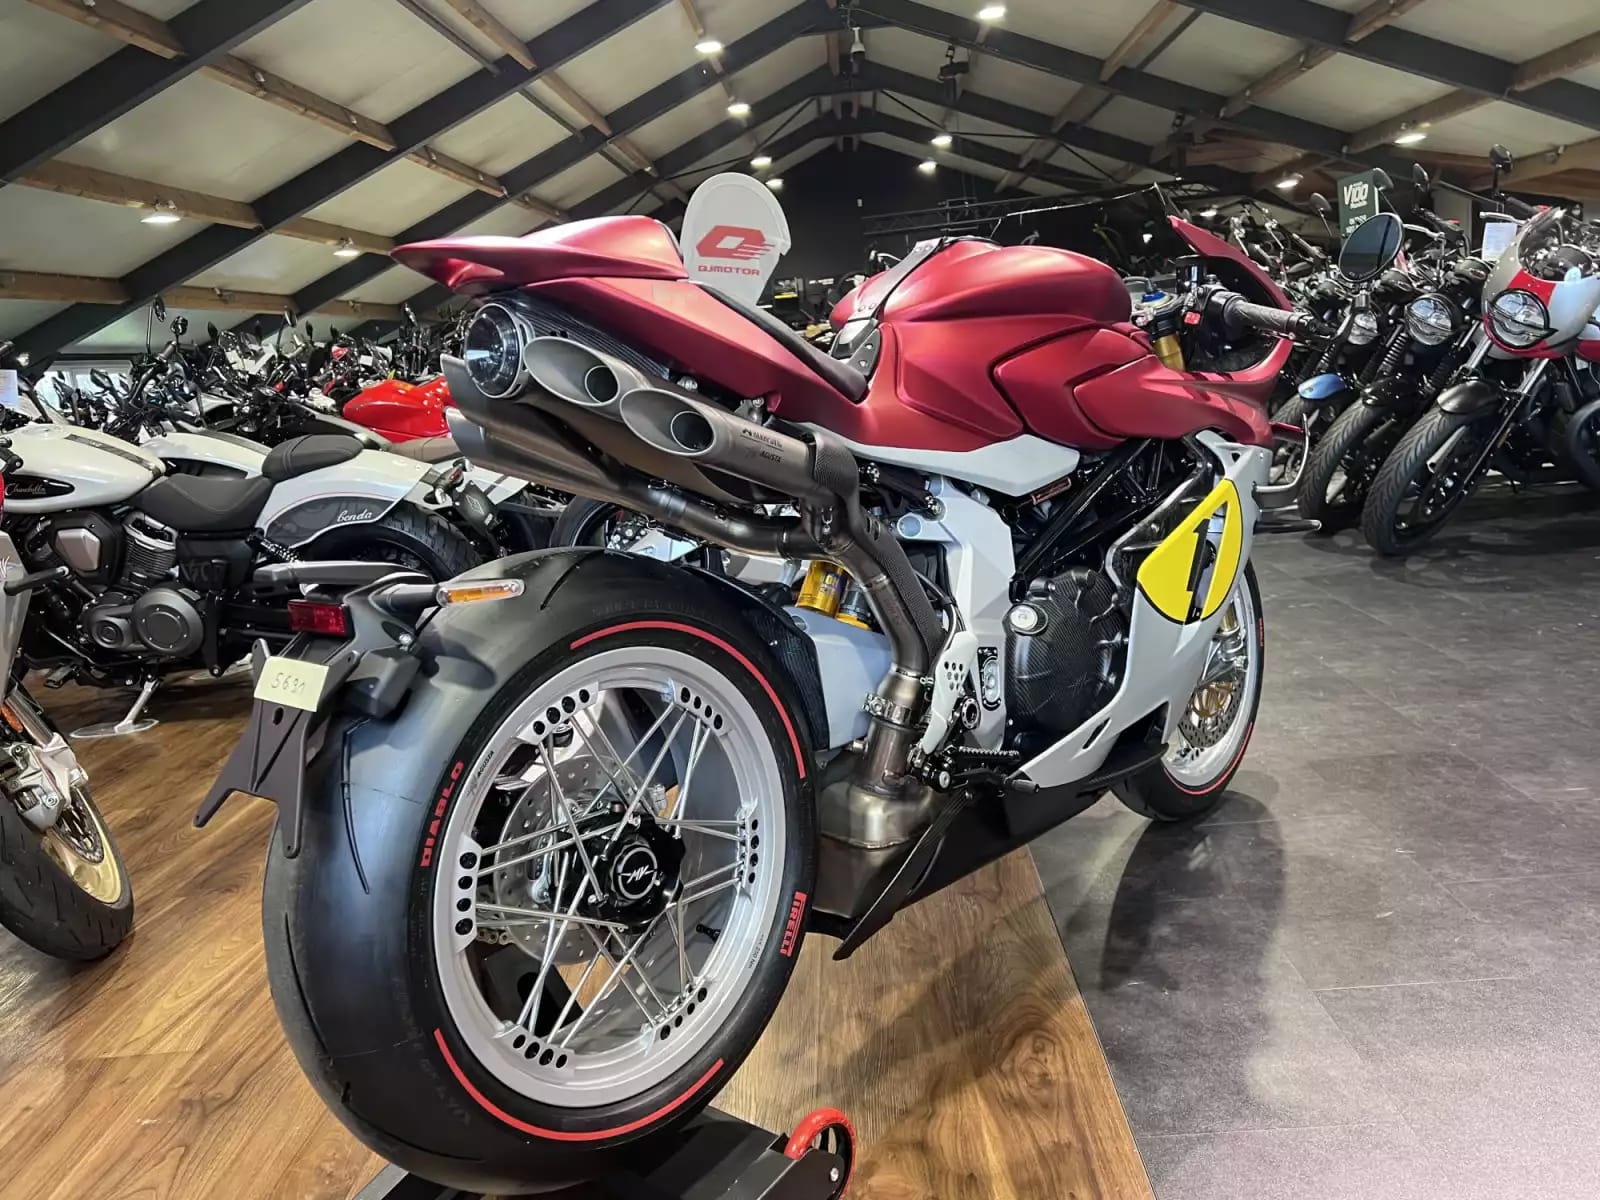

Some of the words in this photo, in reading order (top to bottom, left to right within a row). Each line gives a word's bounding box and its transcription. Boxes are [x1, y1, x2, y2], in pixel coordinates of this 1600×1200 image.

[1344, 184, 1369, 205] V100
[697, 265, 760, 276] QJMOTOR
[420, 761, 464, 867] DIABLO
[780, 891, 808, 957] PIRELLI
